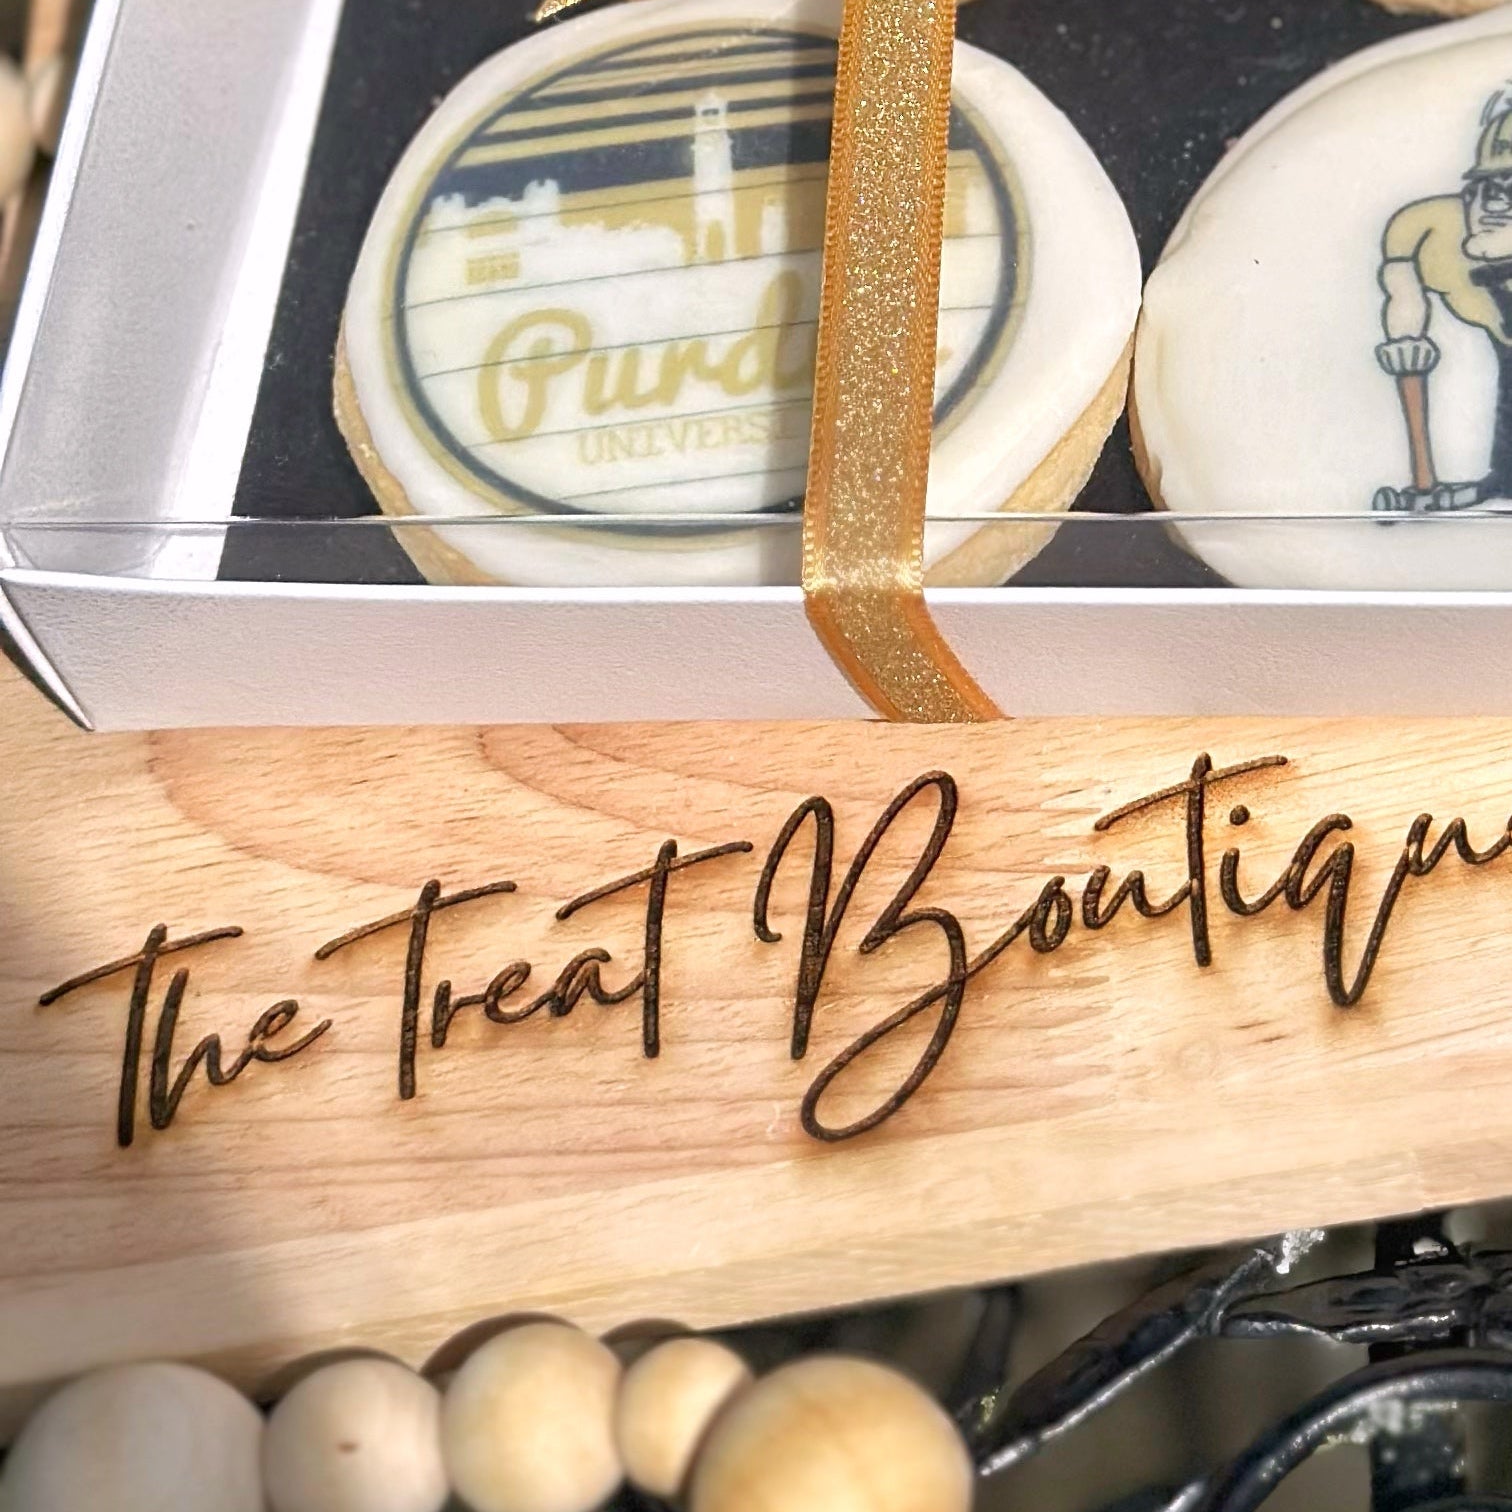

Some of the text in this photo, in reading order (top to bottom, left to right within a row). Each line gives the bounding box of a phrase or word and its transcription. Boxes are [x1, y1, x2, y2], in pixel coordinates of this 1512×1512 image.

[476, 270, 953, 440] Purd
[577, 408, 808, 466] UNIVERS
[40, 923, 333, 1148] The
[315, 838, 753, 1100] Treat
